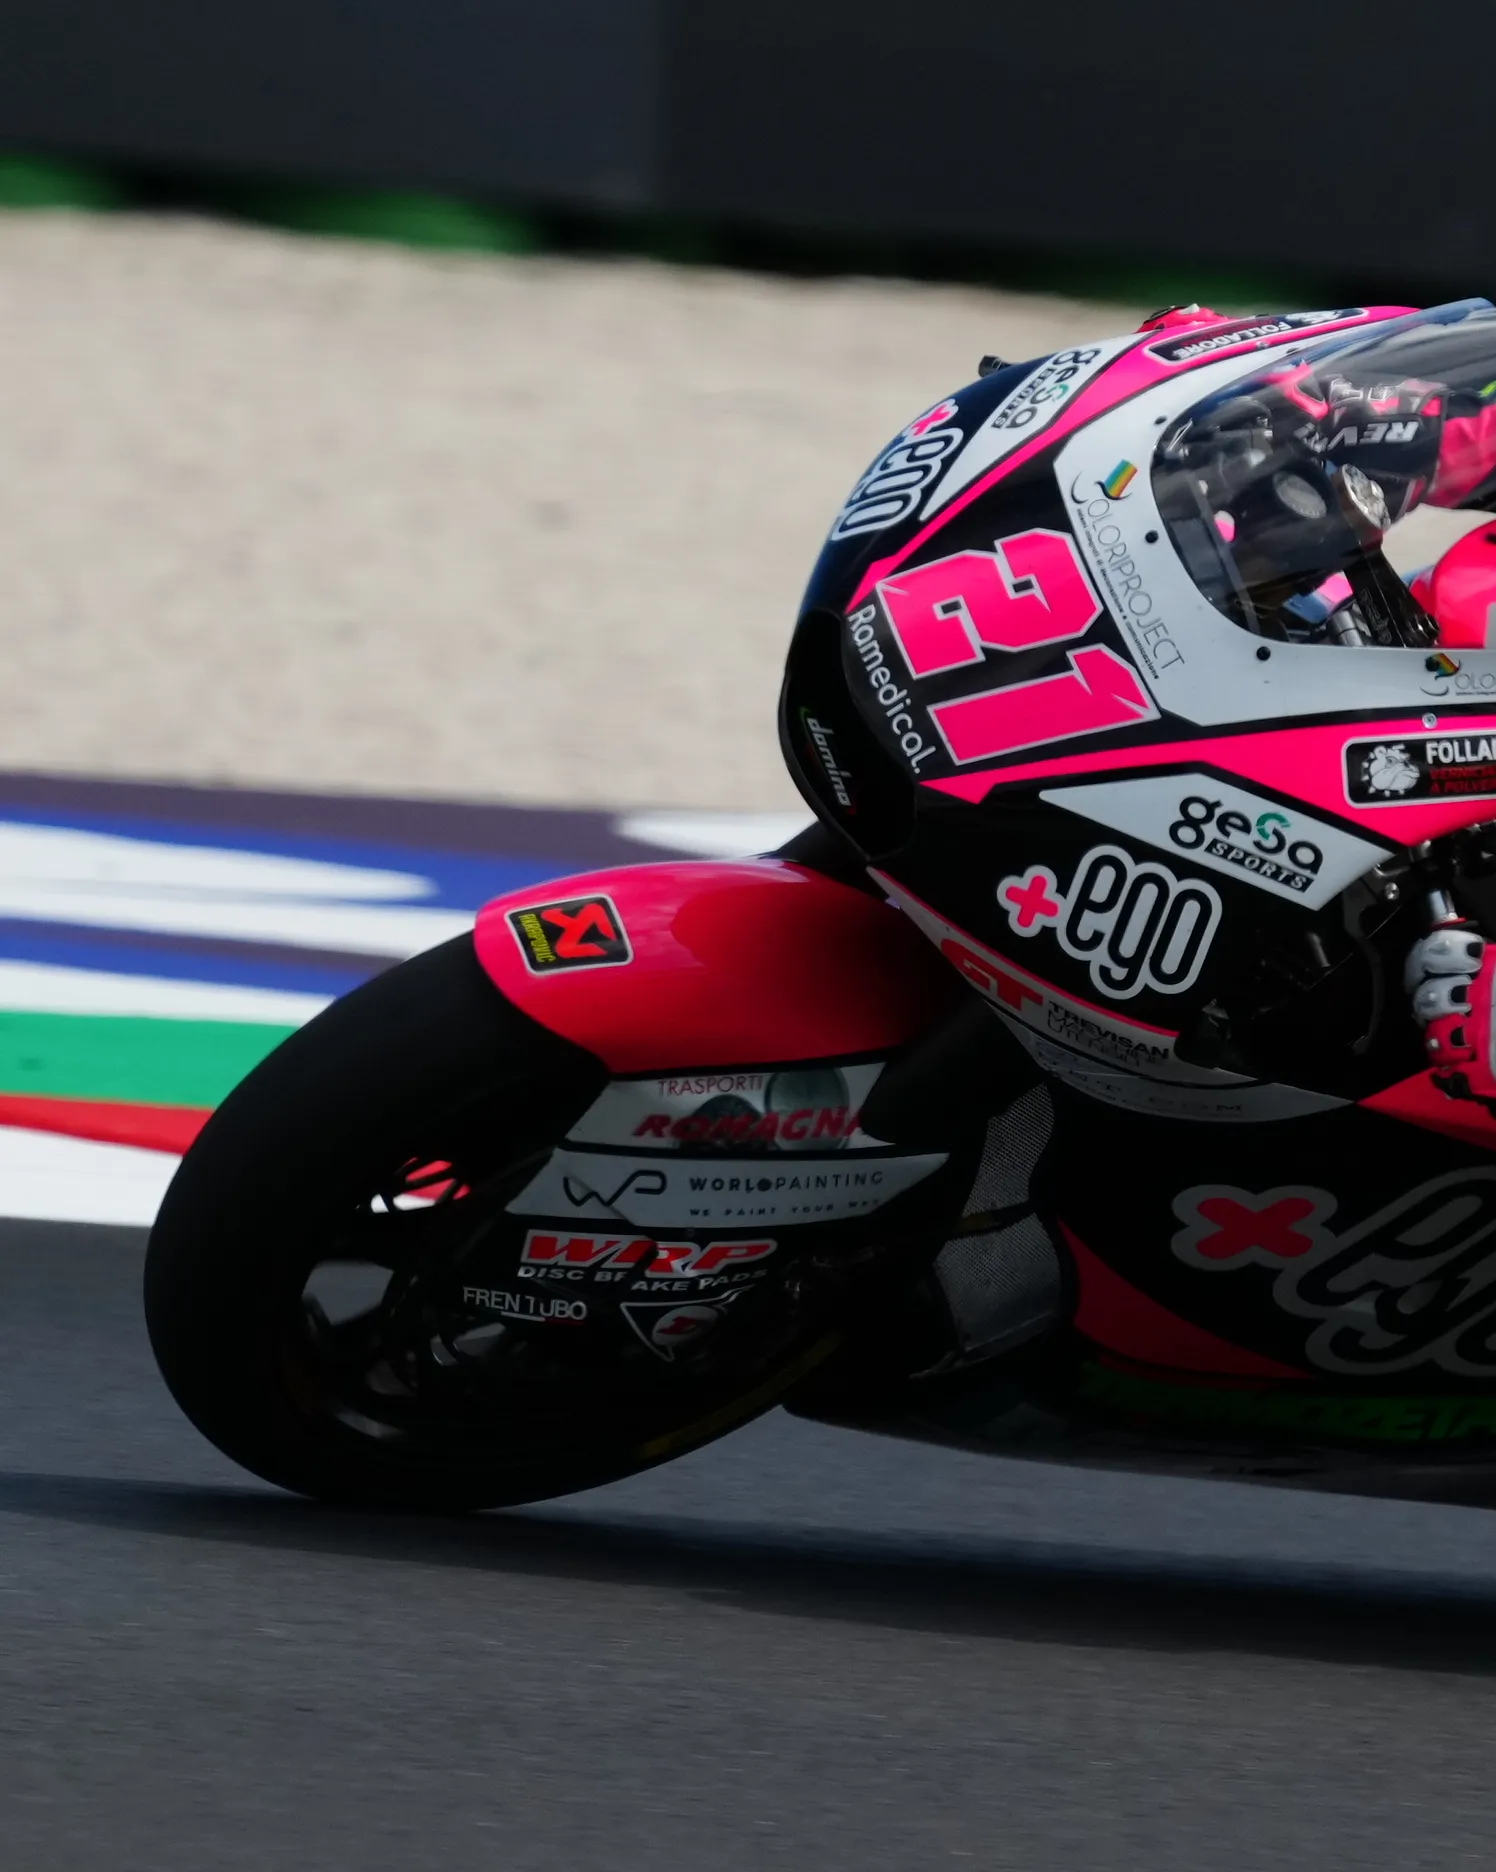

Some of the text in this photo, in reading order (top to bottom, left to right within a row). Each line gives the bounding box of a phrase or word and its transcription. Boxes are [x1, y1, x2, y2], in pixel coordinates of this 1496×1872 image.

[876, 528, 1162, 767] 21
[1168, 796, 1324, 875] gesa
[1204, 838, 1315, 892] SPORTS
[657, 1074, 764, 1097] TRASPORTI
[689, 1170, 884, 1194] WORLPAINTING
[516, 1265, 586, 1282] DISC
[519, 1228, 779, 1279] WRP
